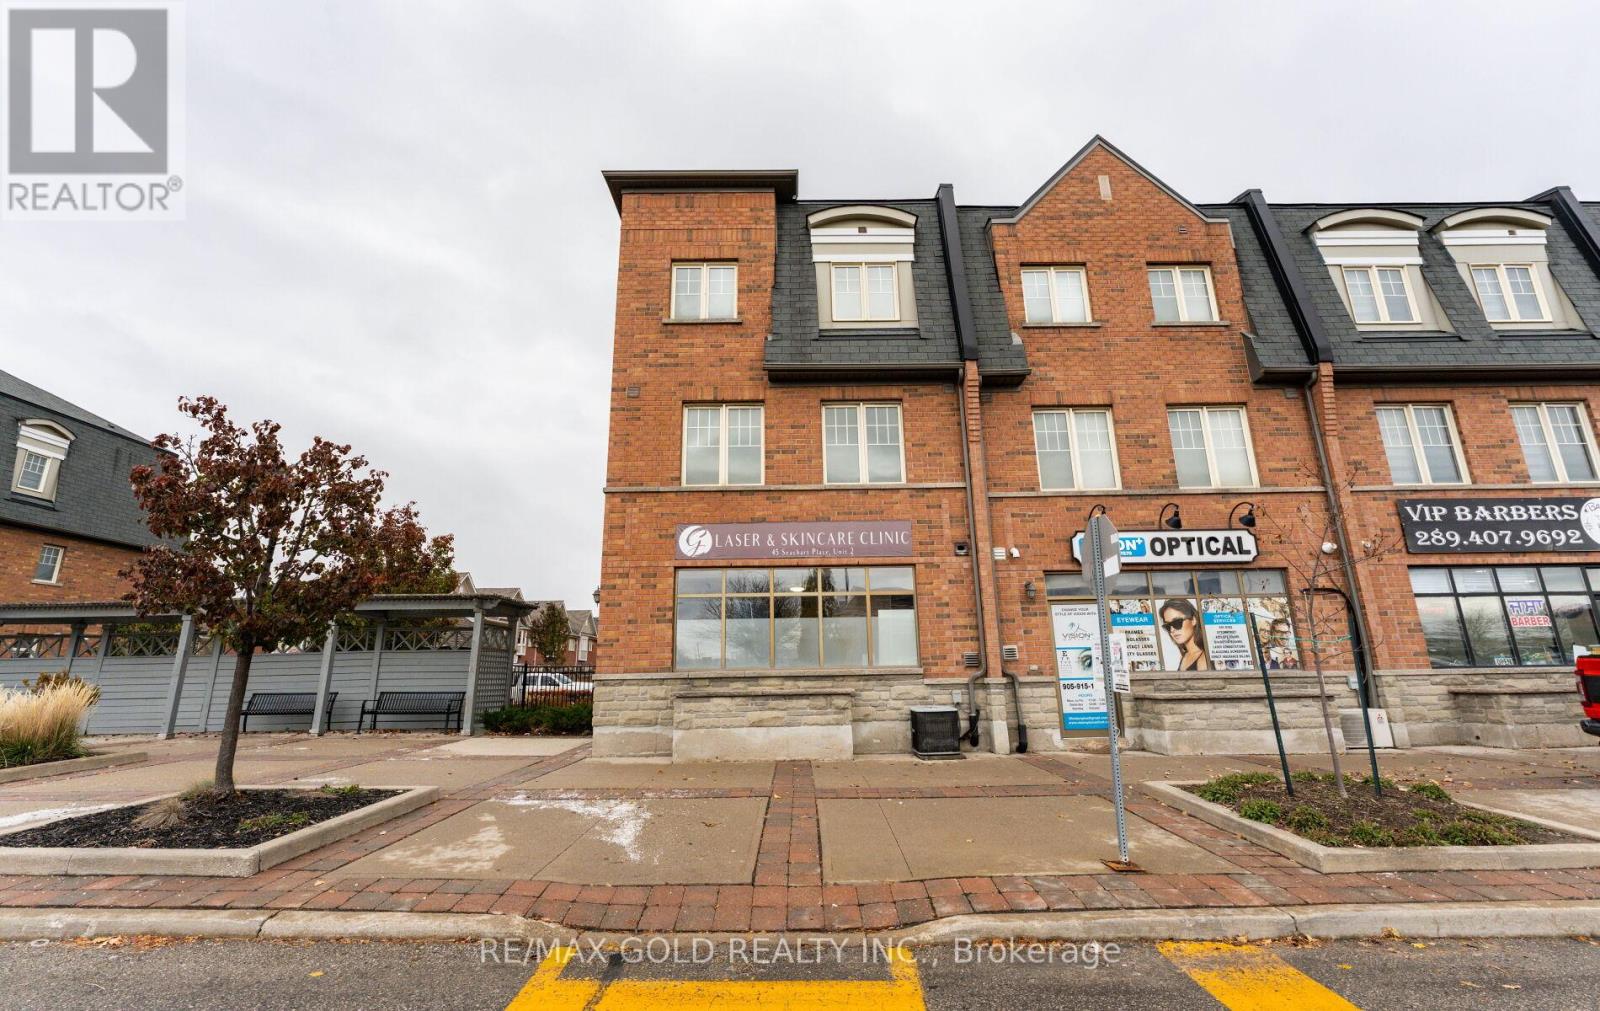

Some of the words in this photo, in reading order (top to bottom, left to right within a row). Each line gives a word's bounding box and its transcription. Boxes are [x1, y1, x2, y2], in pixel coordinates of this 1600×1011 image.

[1404, 504, 1448, 522] VIP
[1454, 504, 1579, 522] BARBERS
[715, 533, 761, 548] LASER
[767, 533, 775, 547] &
[781, 531, 854, 546] SKINCARE
[860, 530, 910, 545] CLINIC
[1415, 527, 1585, 547] 289.407.9692
[833, 547, 848, 555] Unit
[1149, 536, 1252, 557] OPTICAL
[1511, 616, 1551, 627] BARBER
